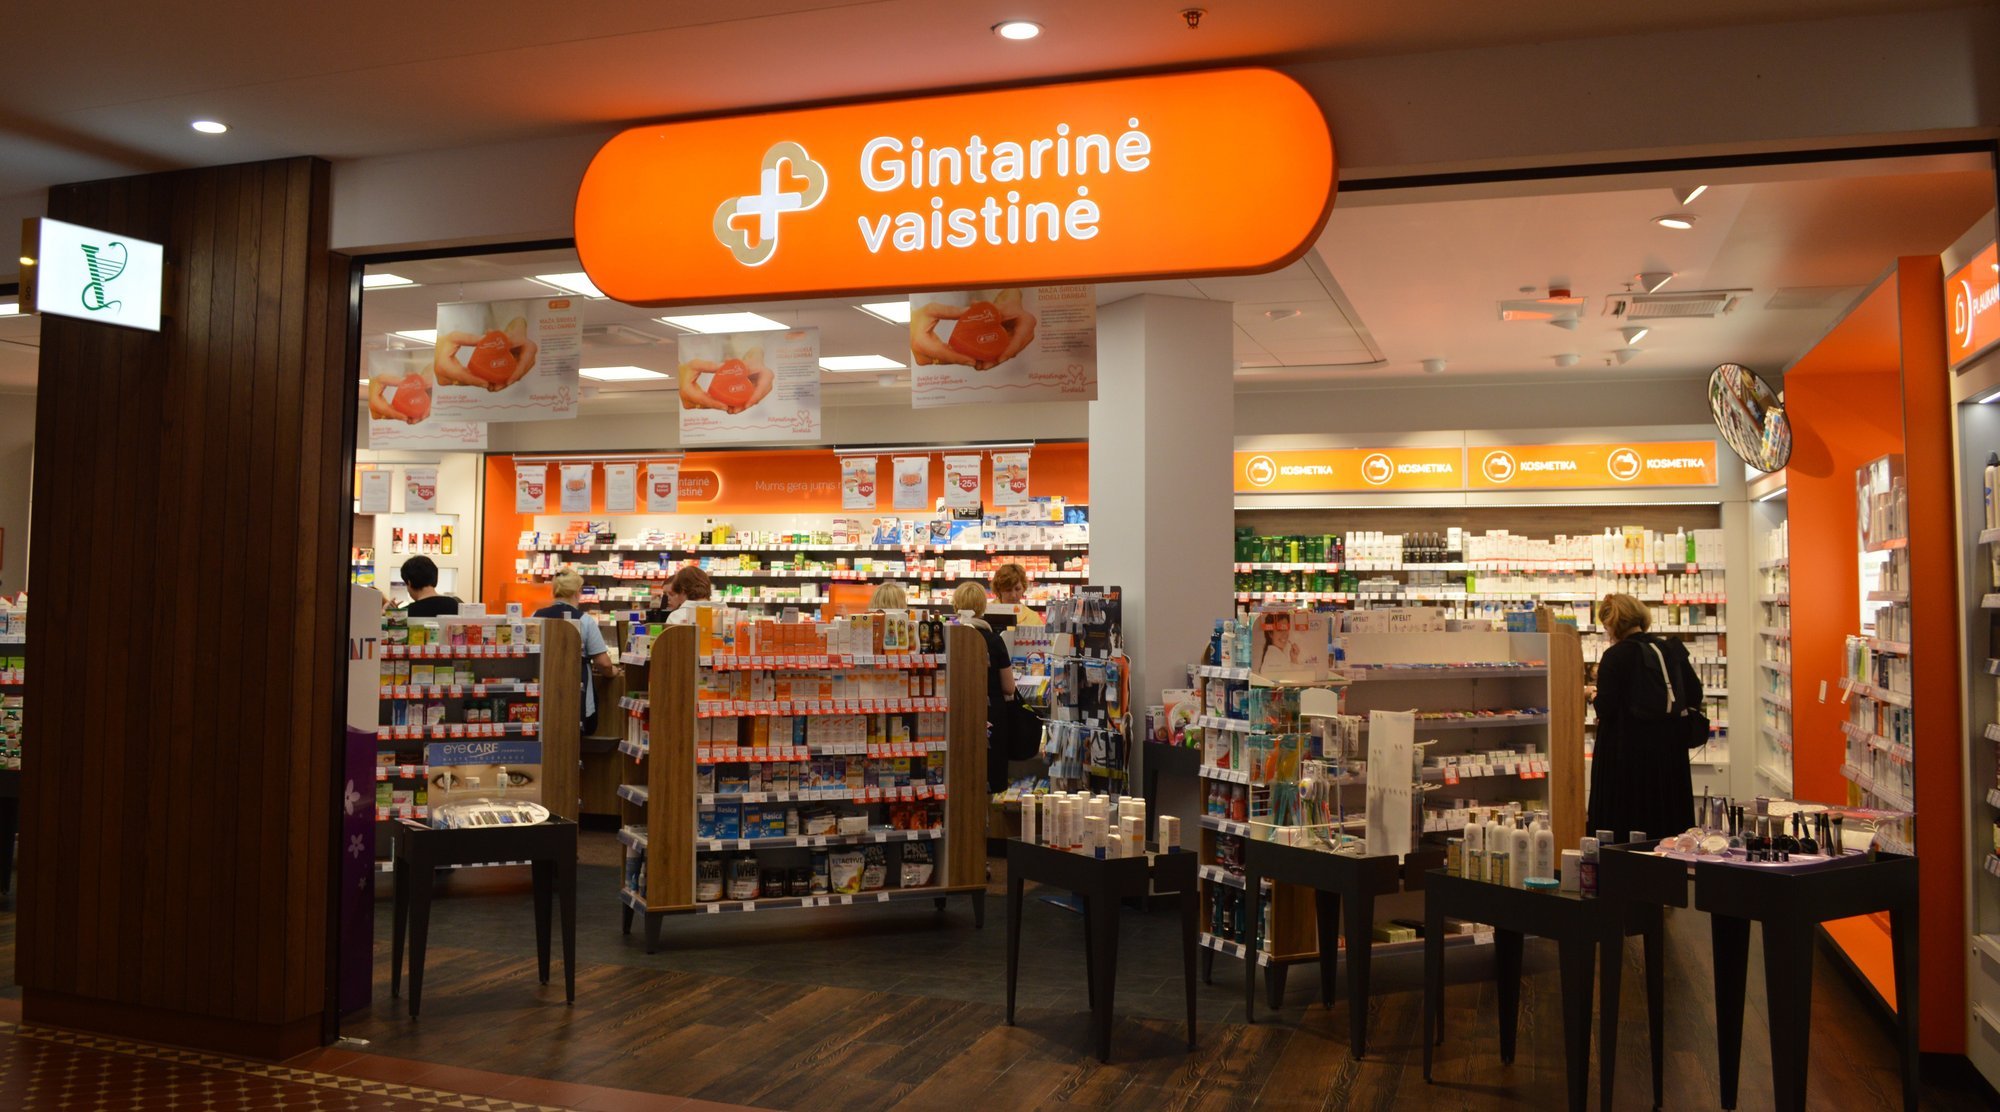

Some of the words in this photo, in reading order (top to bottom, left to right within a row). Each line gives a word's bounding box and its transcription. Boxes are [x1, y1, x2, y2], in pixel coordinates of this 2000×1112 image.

[860, 117, 1151, 192] Gintarinė
[858, 185, 1100, 253] vaistinė
[1398, 463, 1453, 474] KOSMETIKA
[1520, 459, 1577, 471] KOSMETIKA
[1646, 457, 1705, 470] KOSMETIKA
[1280, 465, 1333, 476] KOSMETIKA
[678, 475, 710, 487] ntarinė
[960, 479, 977, 488] -25%
[678, 485, 703, 497] istinė
